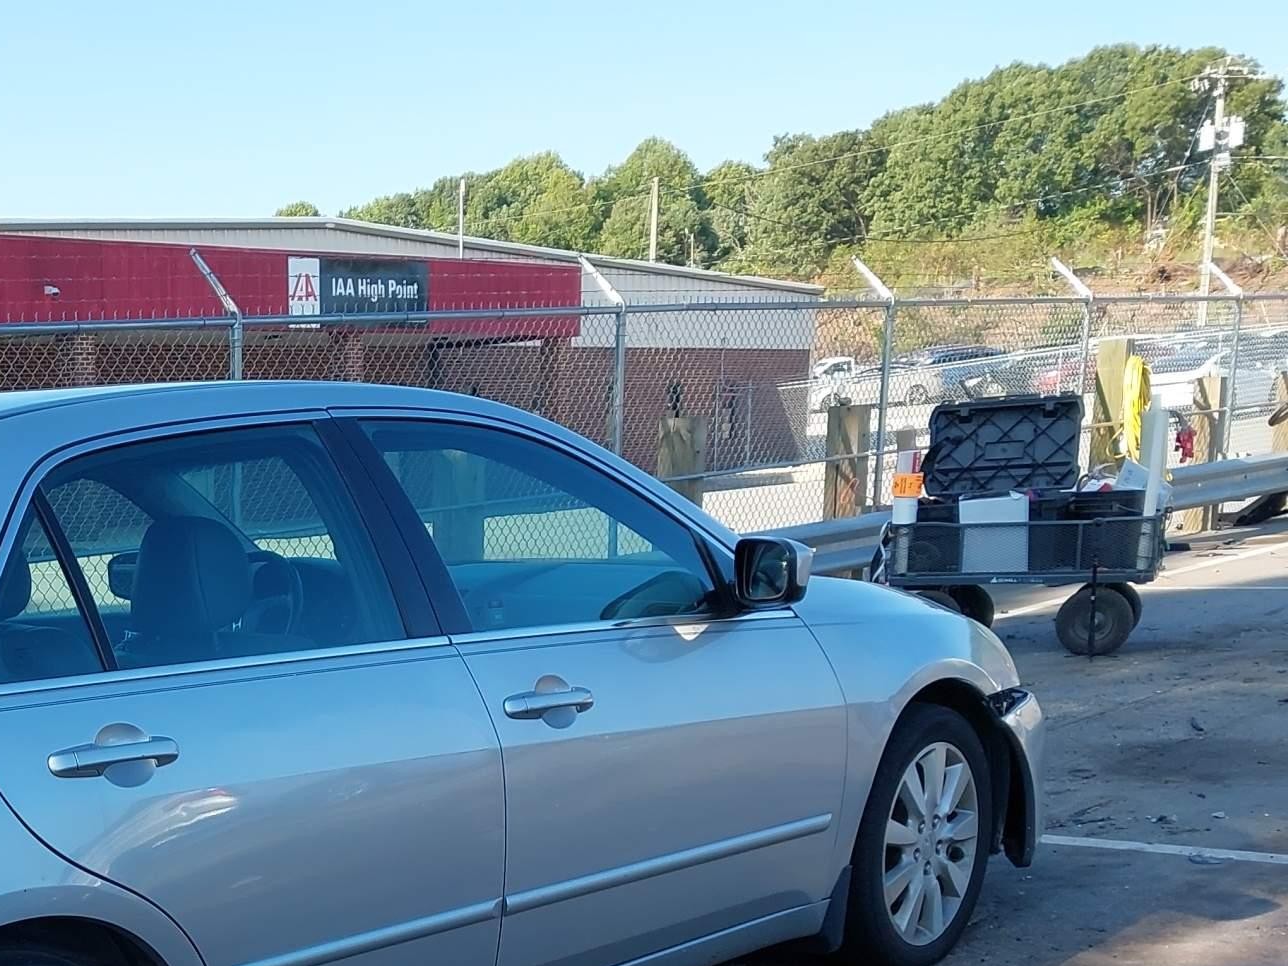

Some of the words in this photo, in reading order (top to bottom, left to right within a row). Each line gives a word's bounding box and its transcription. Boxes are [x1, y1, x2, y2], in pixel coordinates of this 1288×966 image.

[332, 277, 355, 297] IAA
[358, 278, 385, 302] High
[388, 279, 419, 299] Point
